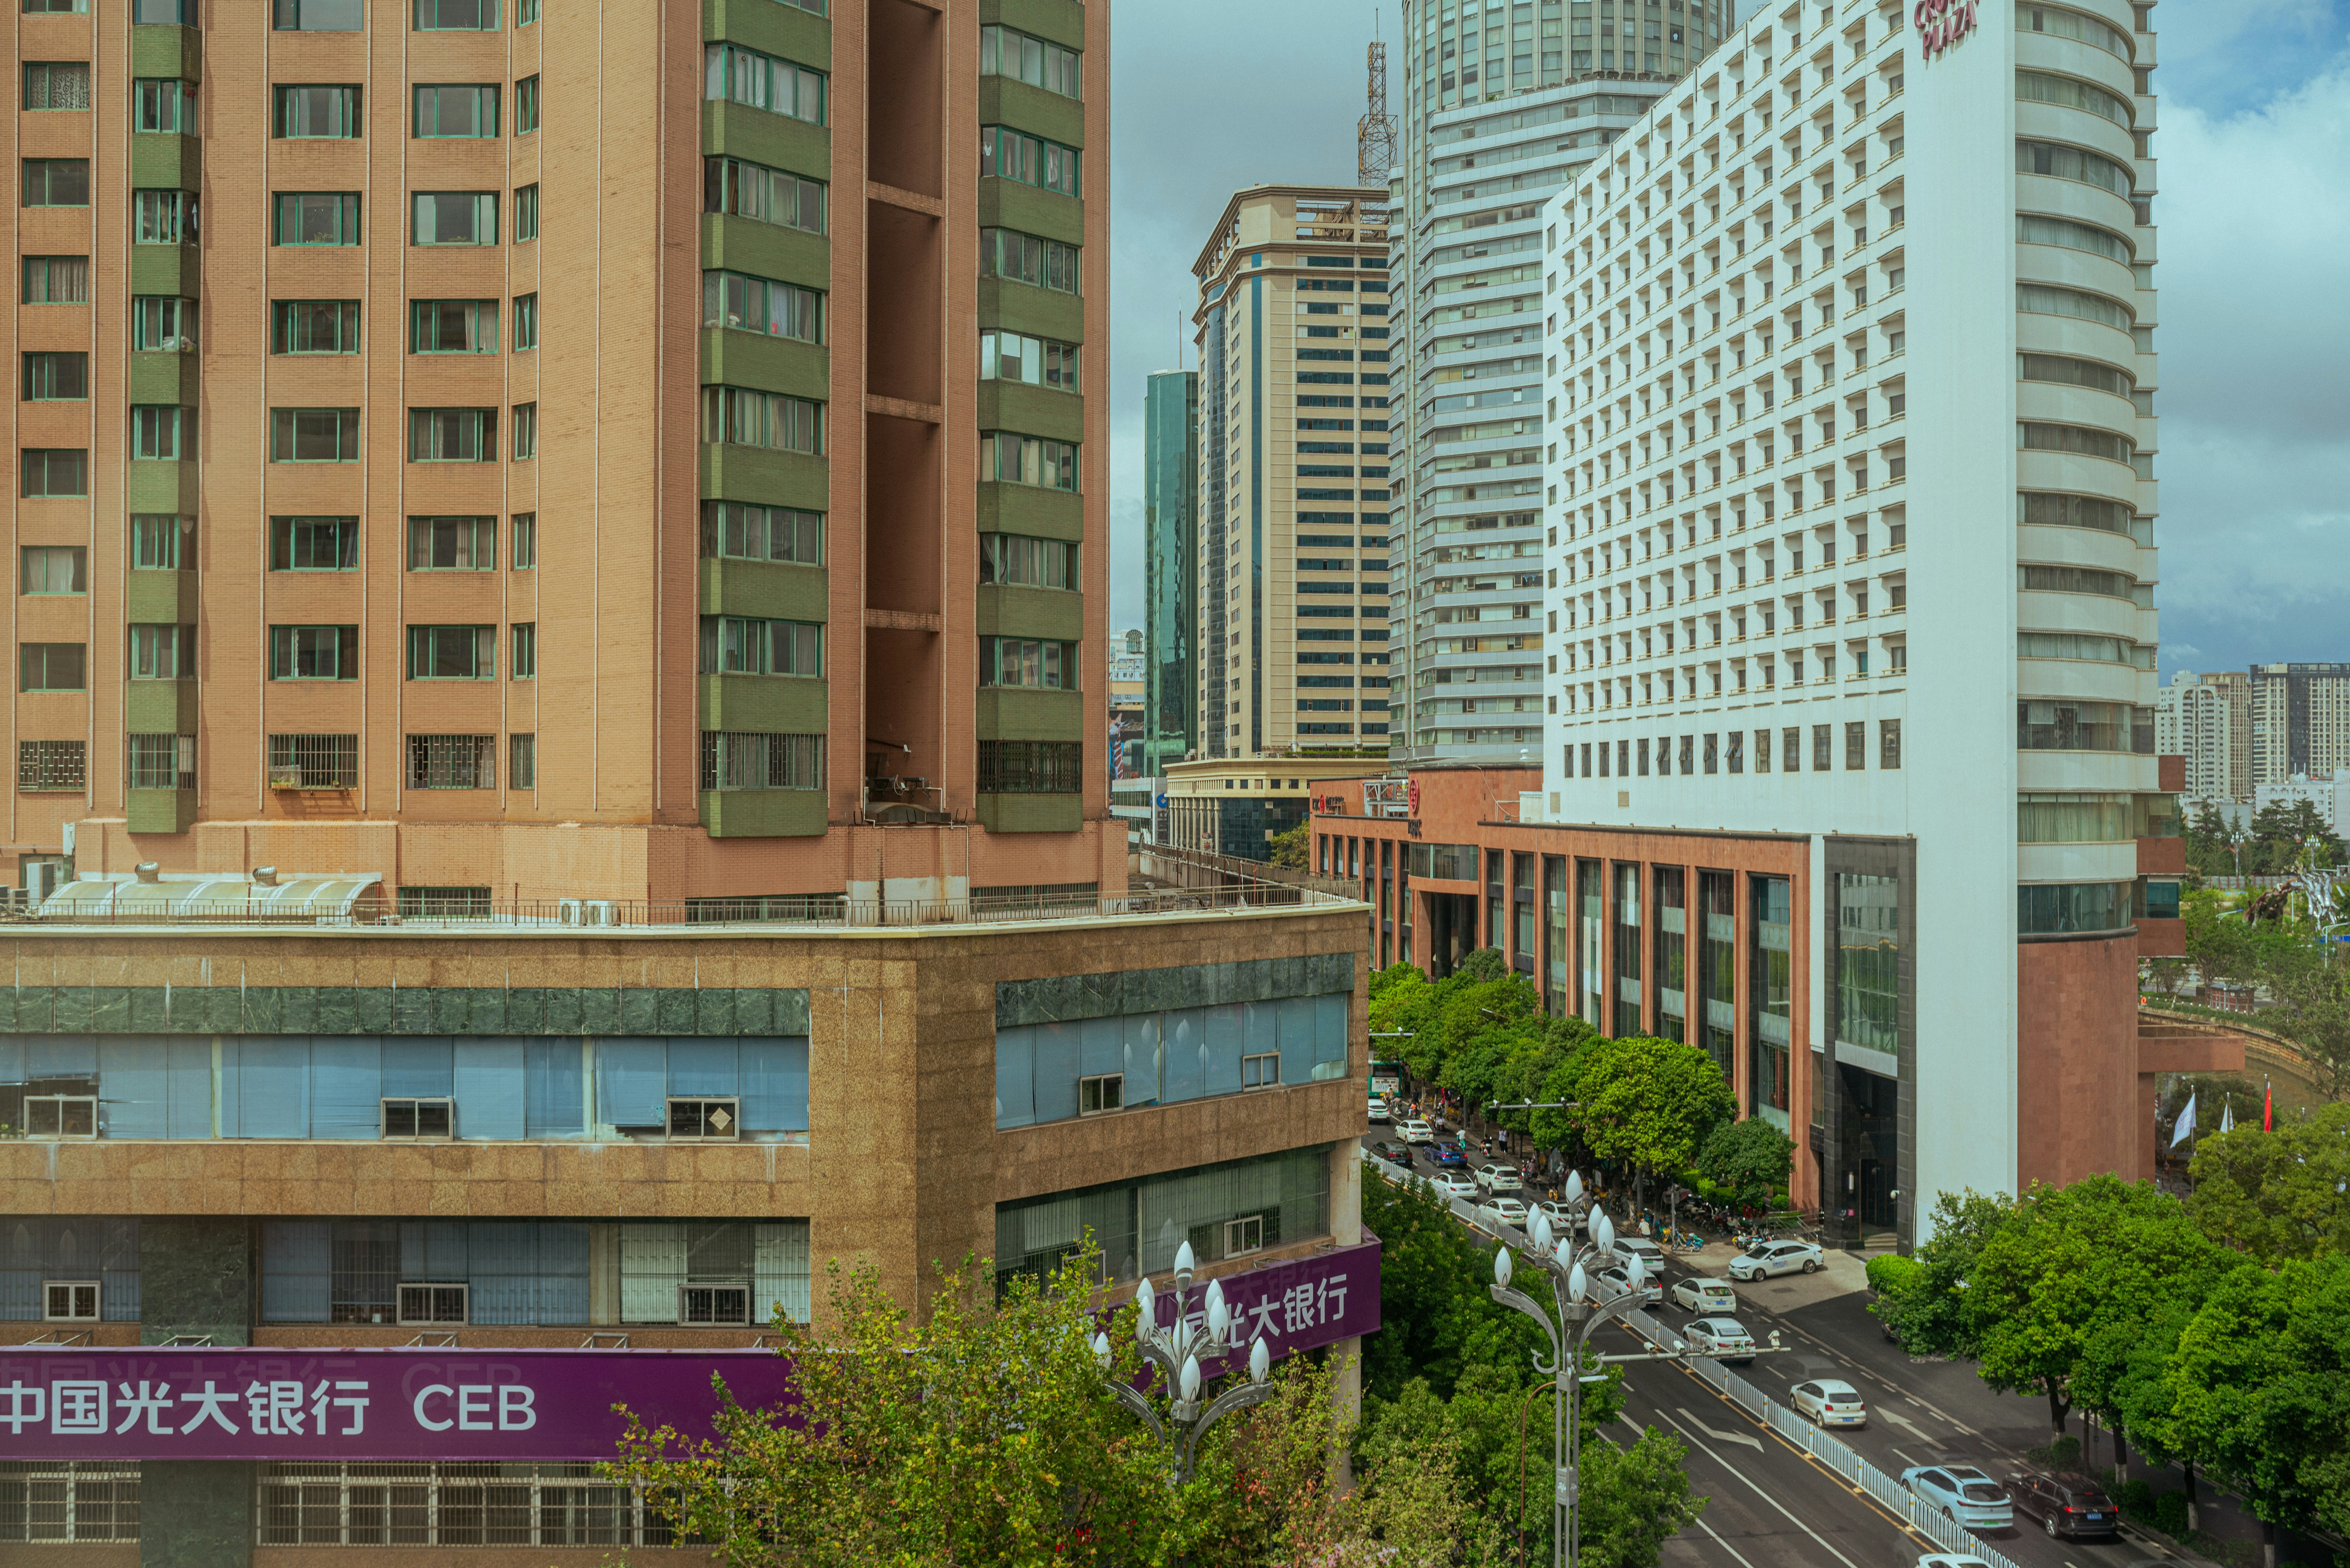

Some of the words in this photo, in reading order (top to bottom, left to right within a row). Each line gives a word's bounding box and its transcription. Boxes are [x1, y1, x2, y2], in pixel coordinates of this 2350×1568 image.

[1923, 0, 1977, 60] PLAZA
[1408, 819, 1421, 835] ICBC
[0, 1379, 369, 1436] 中国光大银行
[413, 1384, 536, 1431] CEB
